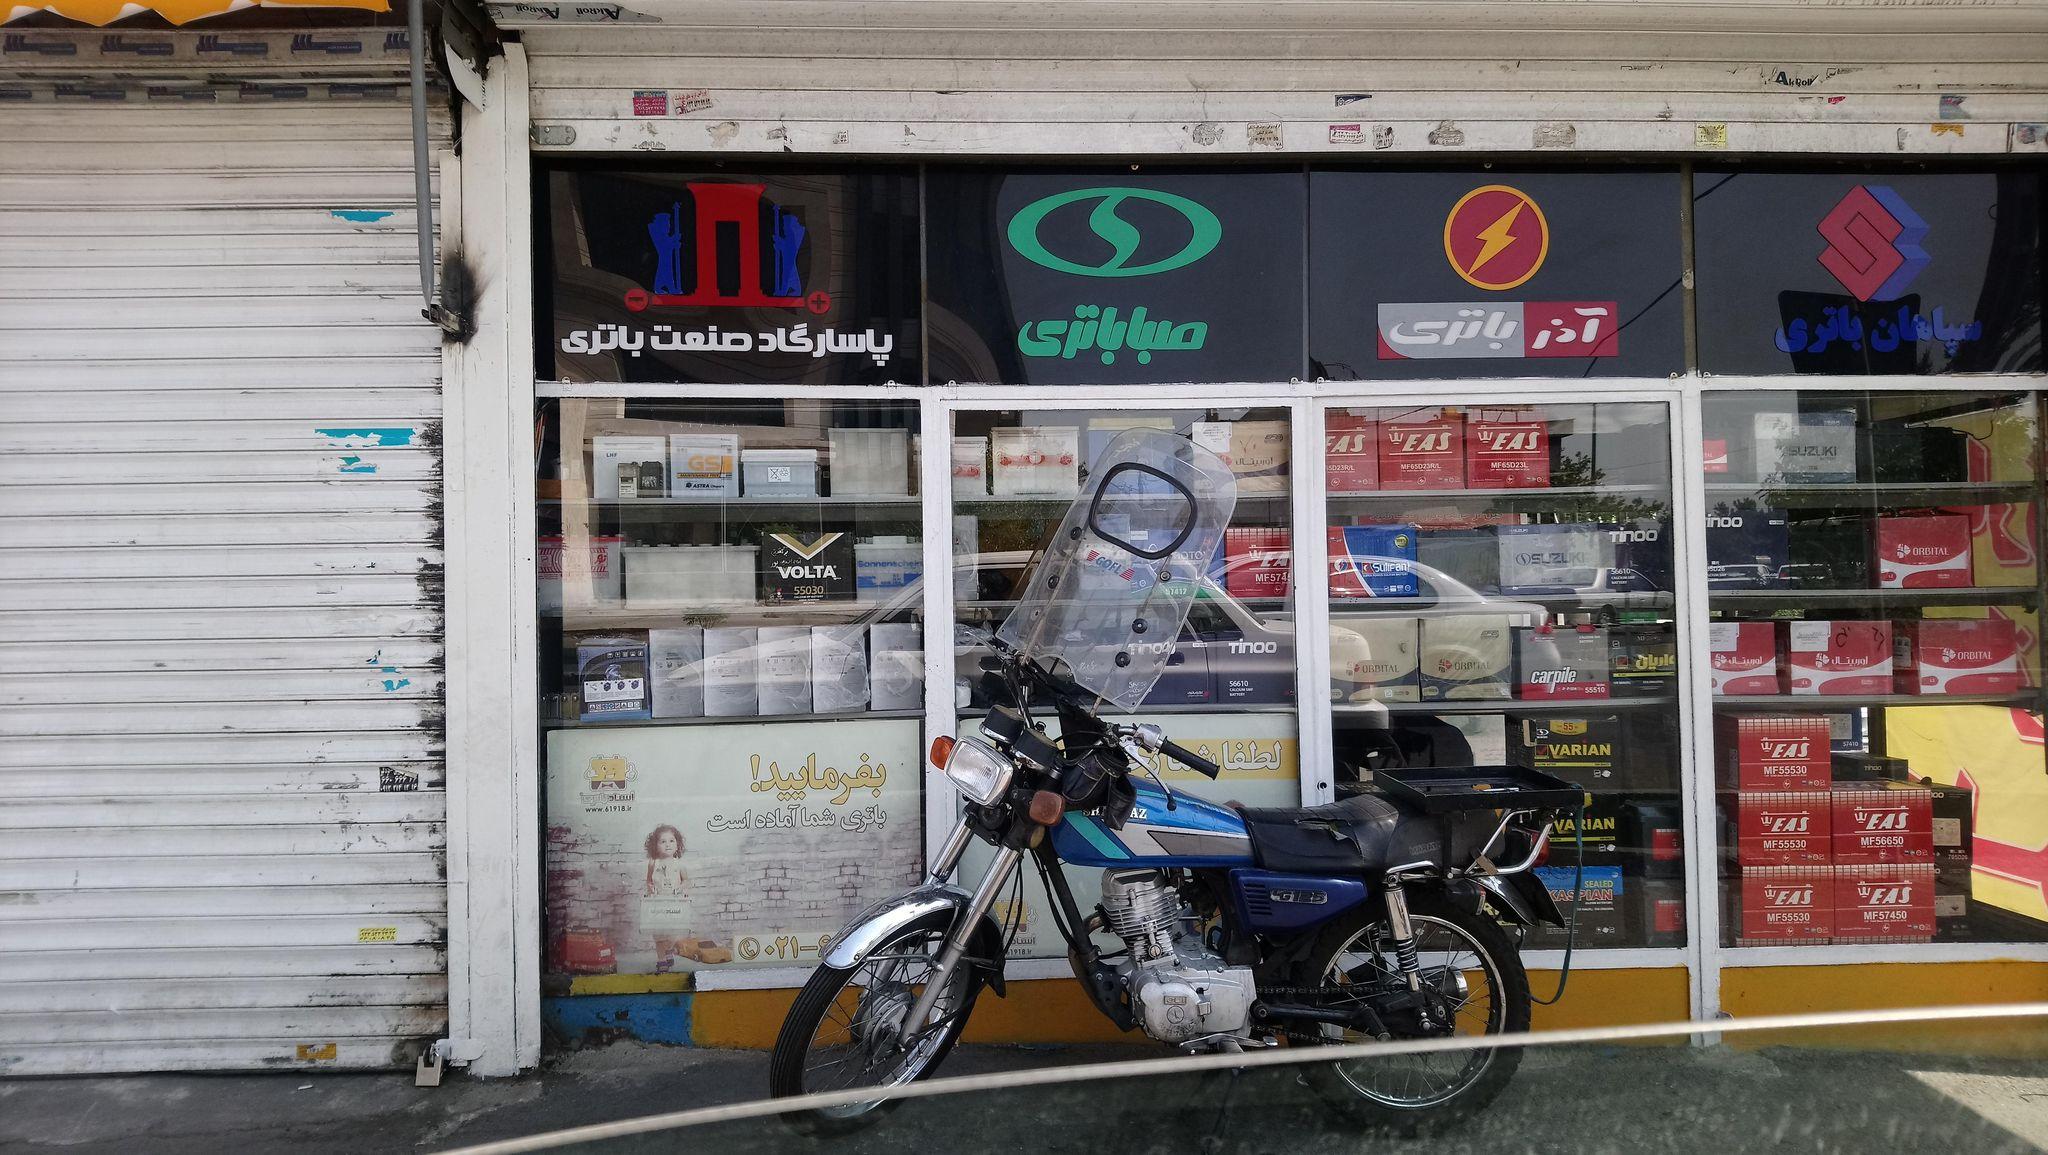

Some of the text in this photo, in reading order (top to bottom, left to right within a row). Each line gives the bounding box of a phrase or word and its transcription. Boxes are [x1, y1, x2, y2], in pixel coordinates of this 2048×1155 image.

[1389, 307, 1608, 350] آذر باتری
[1774, 305, 1982, 356] سپاهان باتری
[561, 323, 893, 366] پاسارگاد صنعت باتری
[1401, 432, 1452, 452] EAS
[1490, 432, 1540, 450] EAS
[1912, 547, 1950, 556] ORBITAL
[778, 564, 837, 579] VOLTA
[793, 585, 824, 596] 55030
[1956, 651, 1992, 660] ORBITAL
[1362, 665, 1400, 673] ORBITAL
[1454, 662, 1490, 671] ORBITAL
[1530, 667, 1577, 693] carpile
[1584, 686, 1605, 694] 55510
[1563, 722, 1574, 731] 55
[1222, 740, 1283, 771] لطفا
[1549, 743, 1611, 756] VARIAN
[1771, 743, 1810, 758] EAS
[1763, 766, 1807, 775] MF55530
[750, 753, 887, 805] بفرمایید!
[585, 805, 633, 813] www.61918.ir
[707, 804, 887, 833] باتری شما آماده است
[1771, 817, 1810, 833] EAS
[1866, 811, 1907, 830] EAS
[1763, 840, 1807, 849] MF55530
[1860, 836, 1904, 846] MF56650
[1774, 889, 1813, 905] EAS
[1869, 886, 1912, 904] EAS
[1767, 912, 1810, 922] MF55530
[1863, 910, 1907, 920] MF57450
